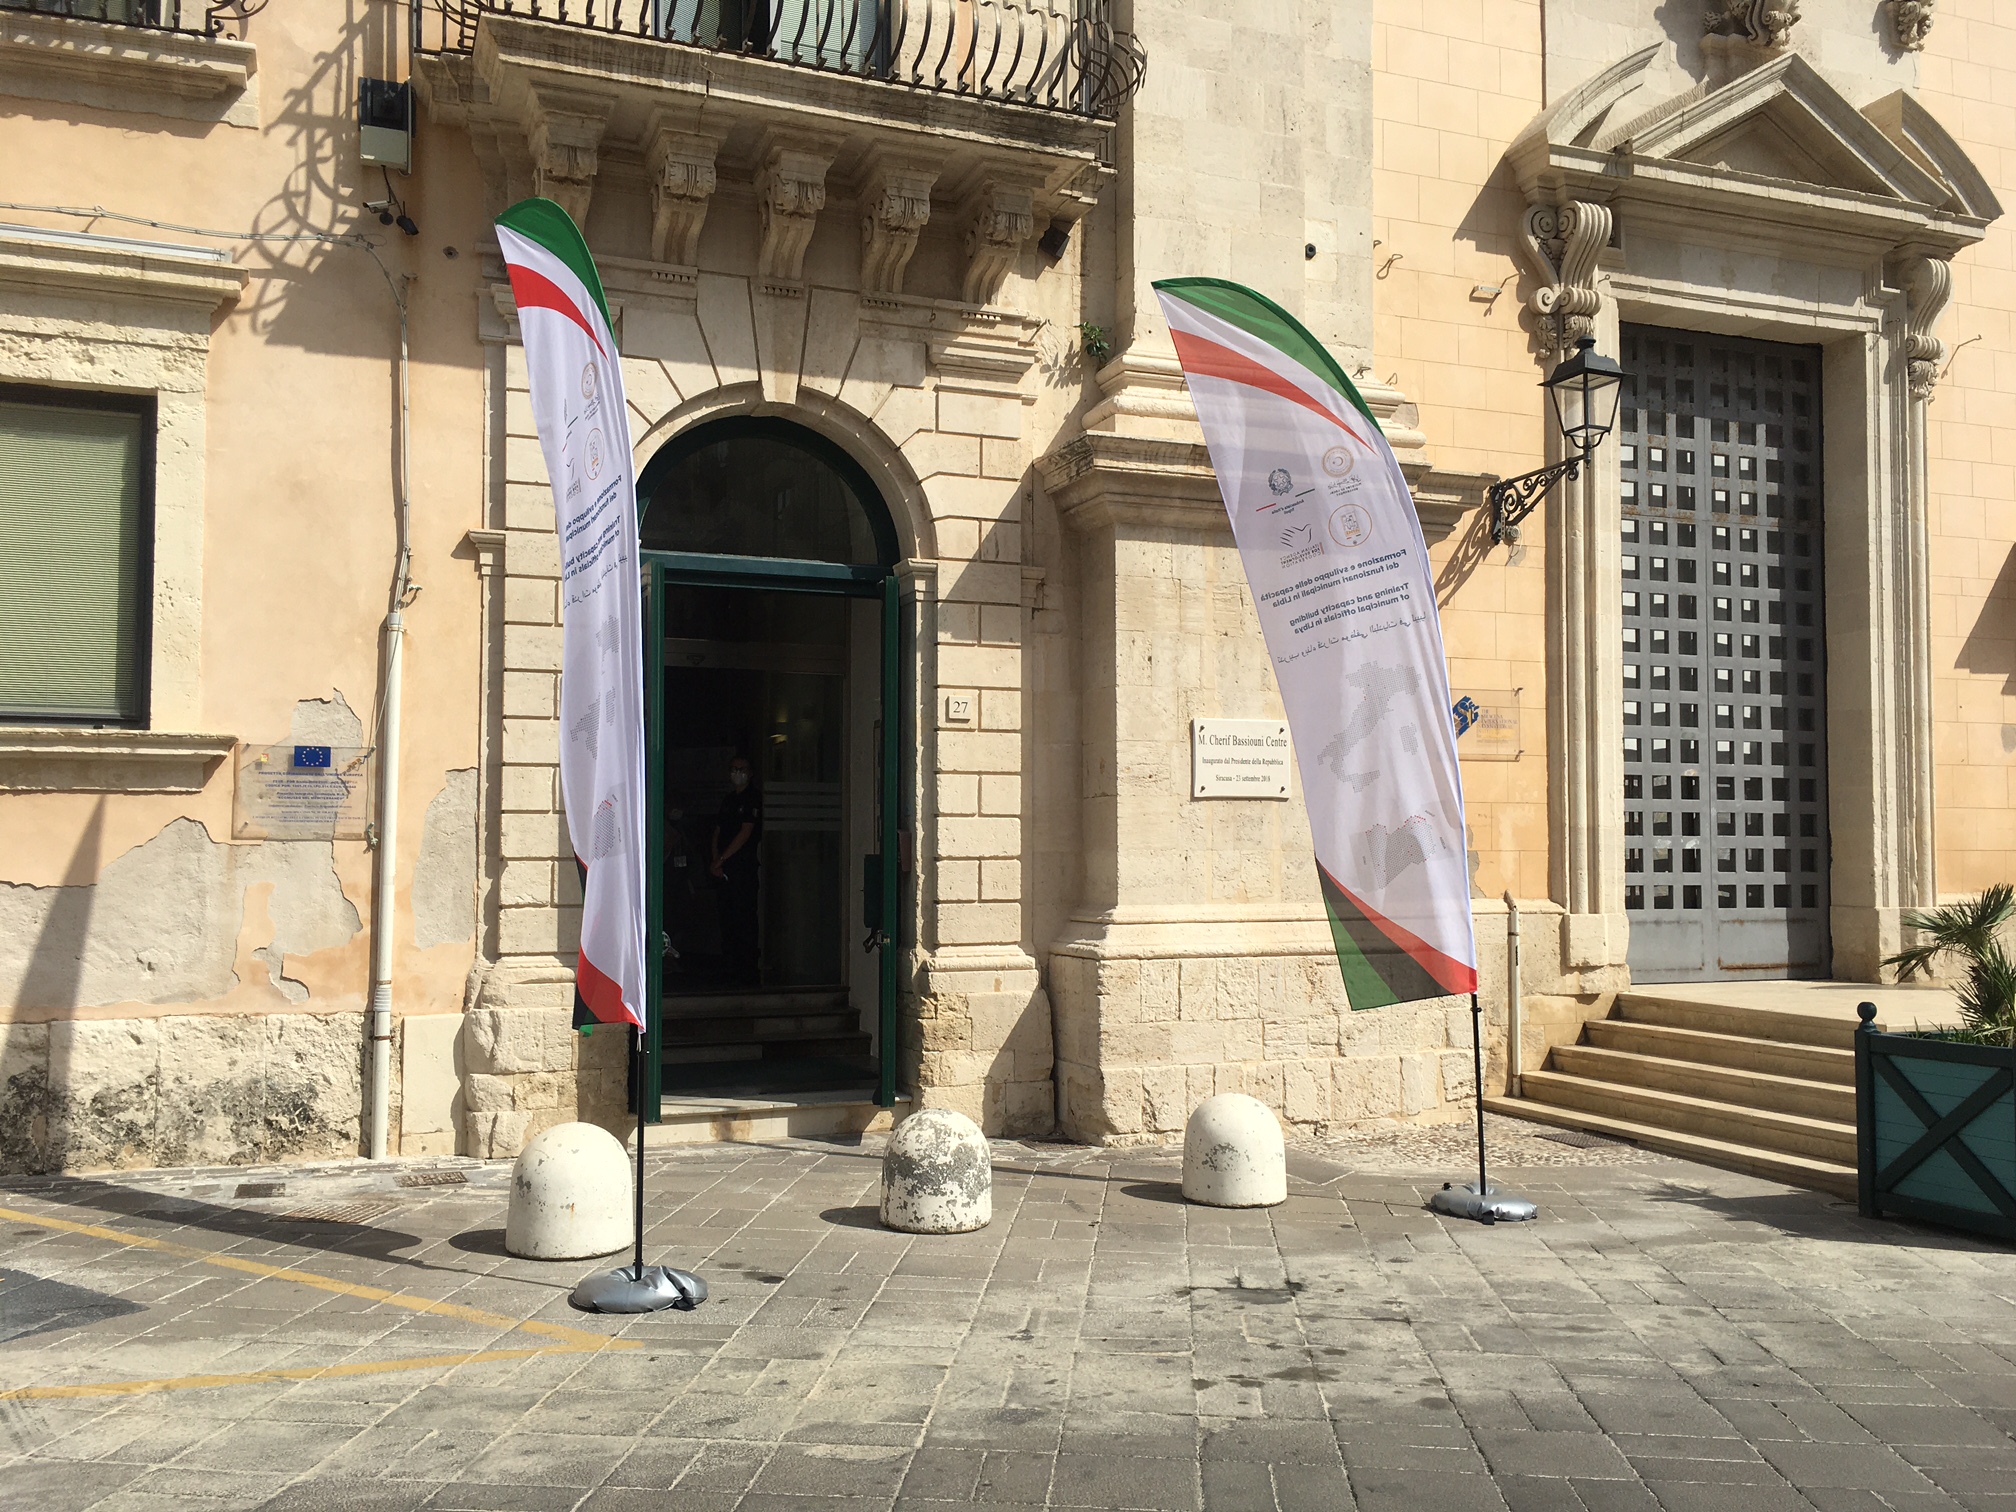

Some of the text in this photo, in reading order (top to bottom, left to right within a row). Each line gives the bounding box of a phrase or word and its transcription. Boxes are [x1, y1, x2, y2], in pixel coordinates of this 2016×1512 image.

[953, 700, 968, 713] 27
[1198, 734, 1287, 747] M. Cherif Bassiouni Centre
[1202, 757, 1223, 765] Inaugurato
